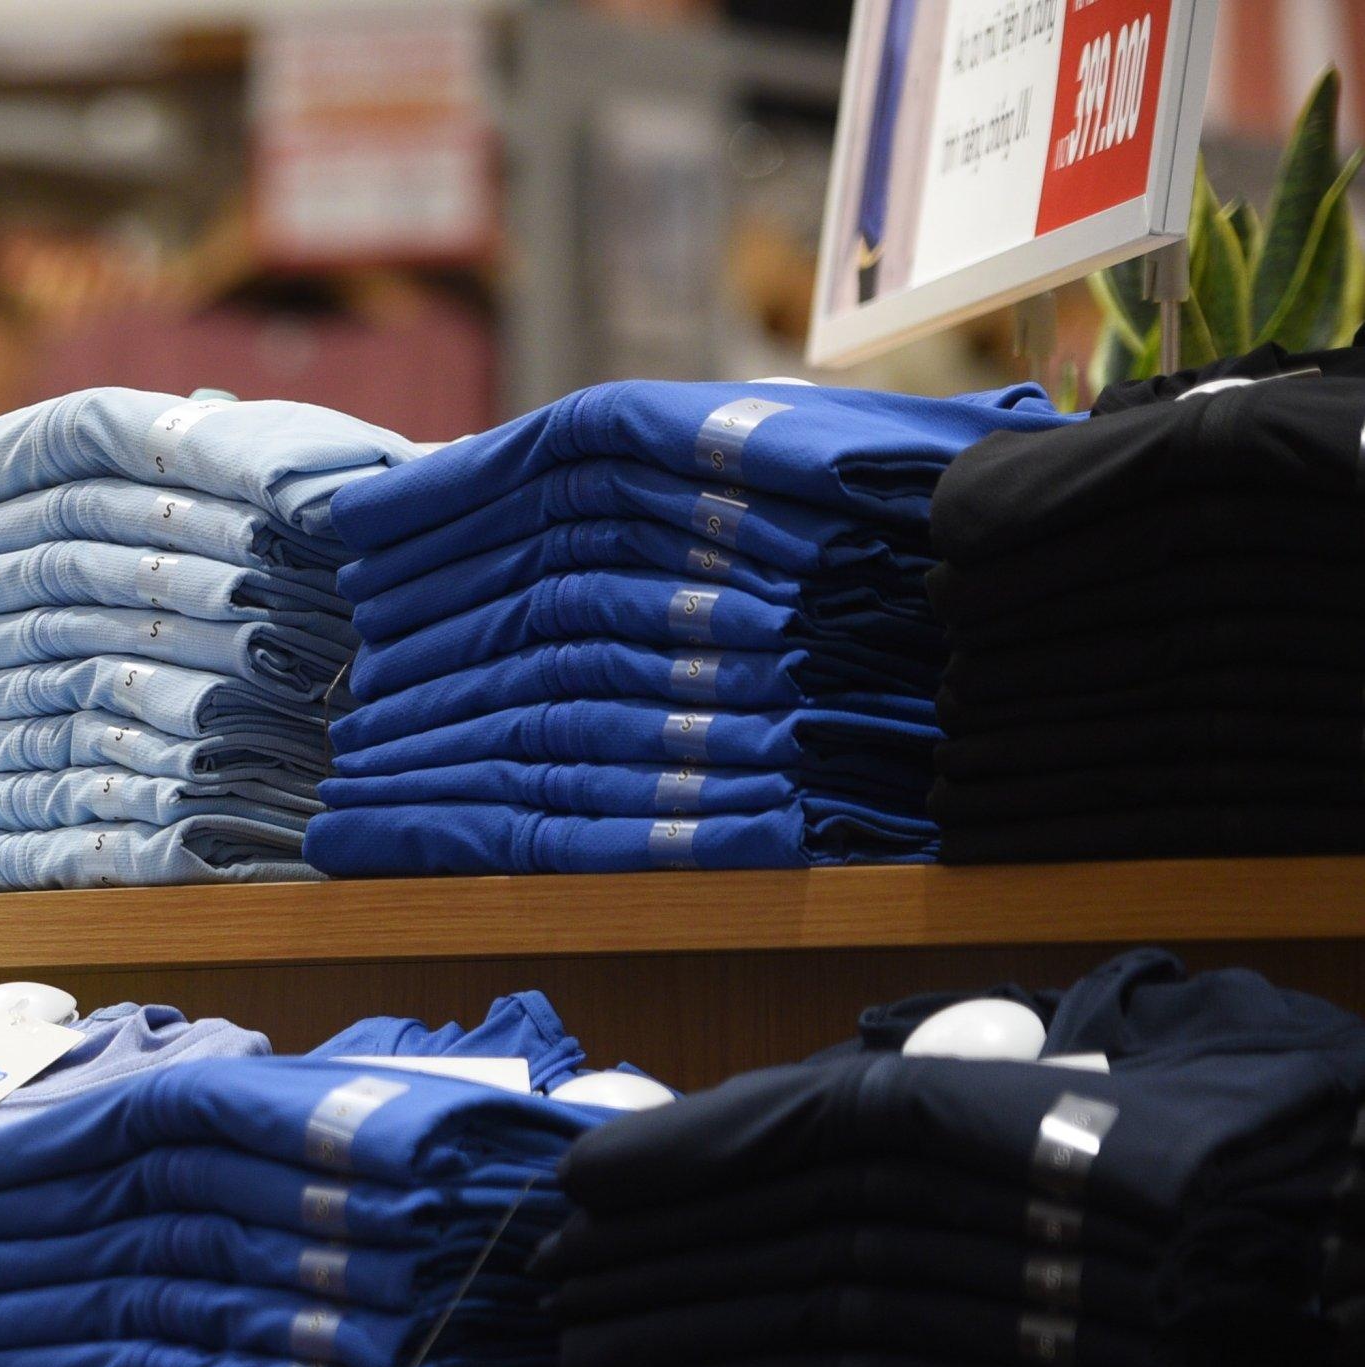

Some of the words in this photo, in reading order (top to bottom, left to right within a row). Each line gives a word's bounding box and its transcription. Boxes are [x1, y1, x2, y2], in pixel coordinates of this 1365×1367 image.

[1067, 13, 1151, 166] 399.000
[166, 418, 181, 431] S
[723, 416, 739, 429] S
[156, 456, 165, 474] S
[711, 450, 725, 471] S
[163, 502, 176, 519] S
[707, 515, 721, 536] S
[151, 556, 165, 571] S
[702, 549, 718, 569] S
[685, 595, 700, 614] S
[150, 620, 162, 638] S
[687, 657, 703, 677] S
[125, 670, 138, 687] S
[680, 712, 696, 732] S
[115, 727, 129, 741] S
[678, 767, 694, 782] S
[103, 776, 114, 793] S
[667, 820, 682, 838] S
[95, 833, 106, 851] S
